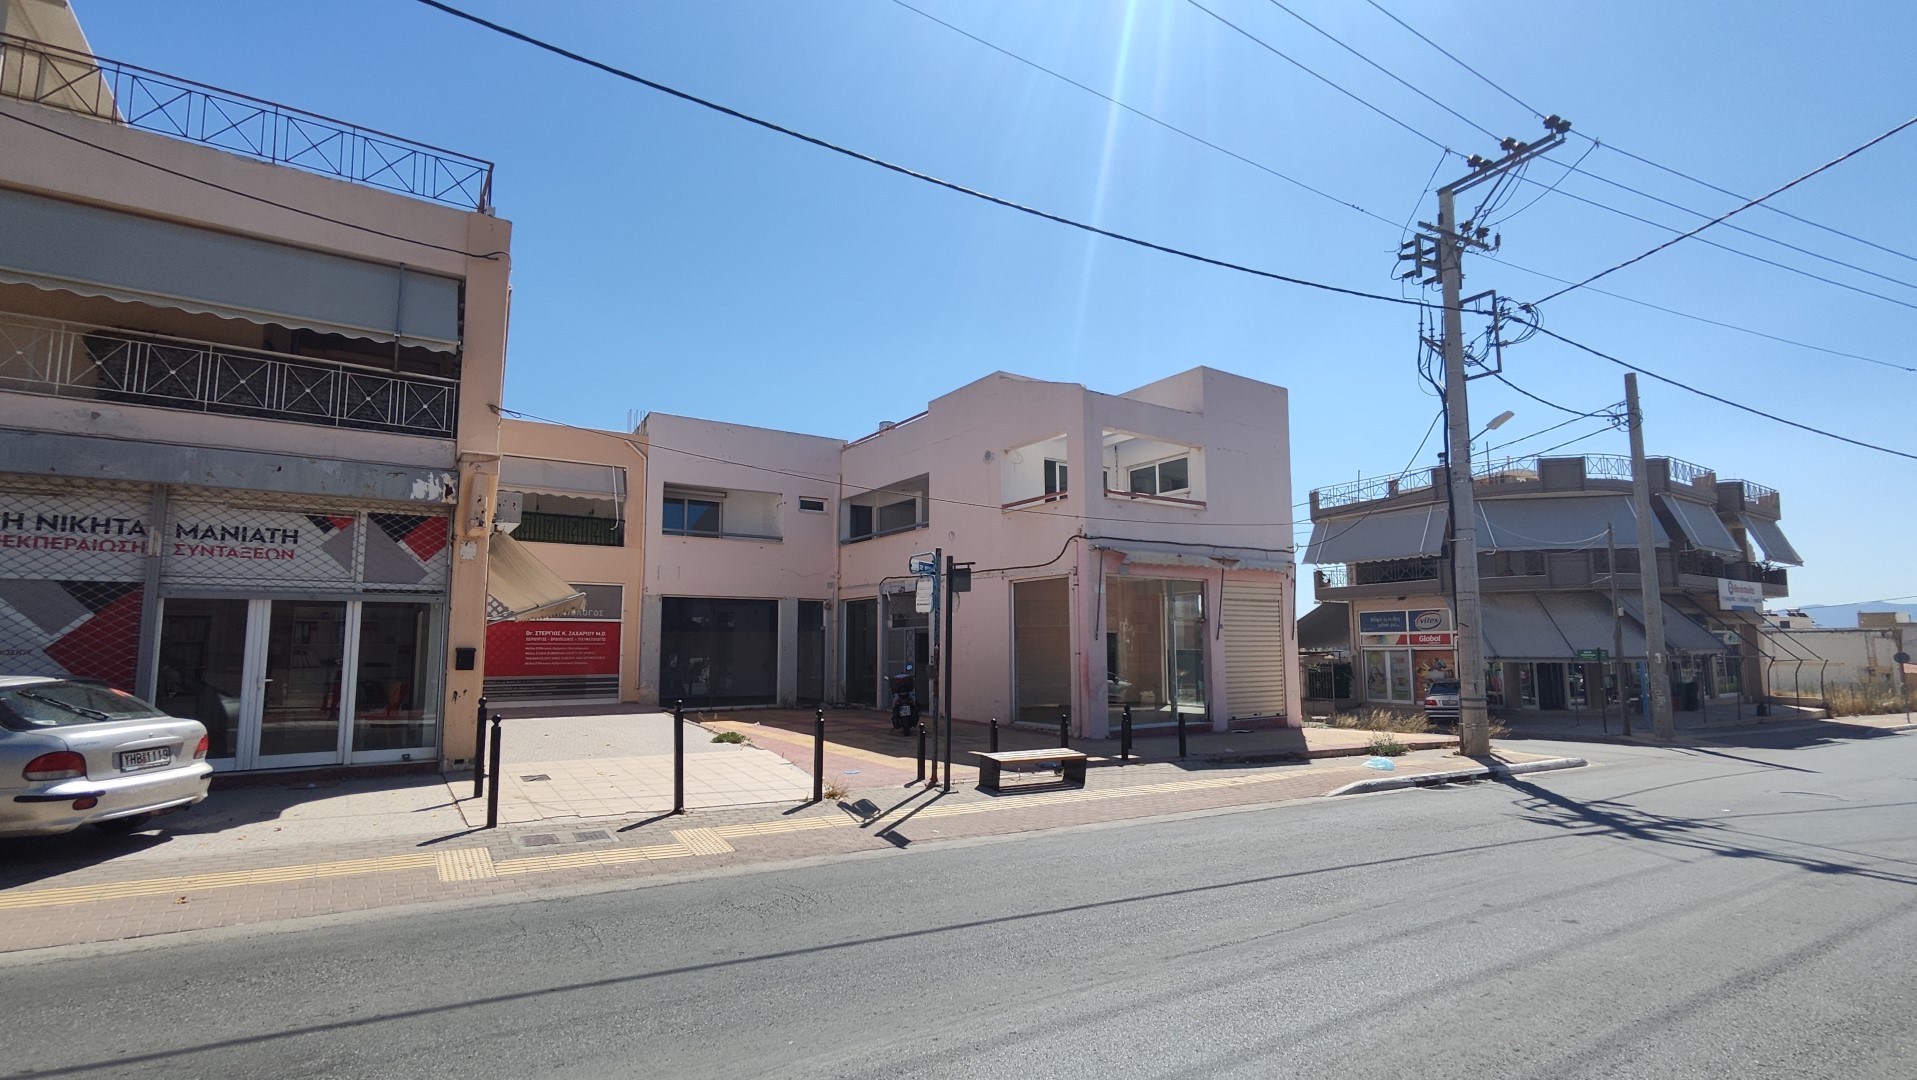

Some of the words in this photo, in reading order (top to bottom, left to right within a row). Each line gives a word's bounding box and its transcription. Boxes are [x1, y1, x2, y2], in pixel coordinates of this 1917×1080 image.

[36, 513, 147, 536] ΝΙΚΗΤΑ
[175, 523, 299, 544] ΜΑΝΙΑΤΗ
[0, 535, 146, 553] ΕΚΠΕΡΑΙΩΣΗ
[173, 543, 295, 560] ΣΥΝΤΑΞΕΩΝ
